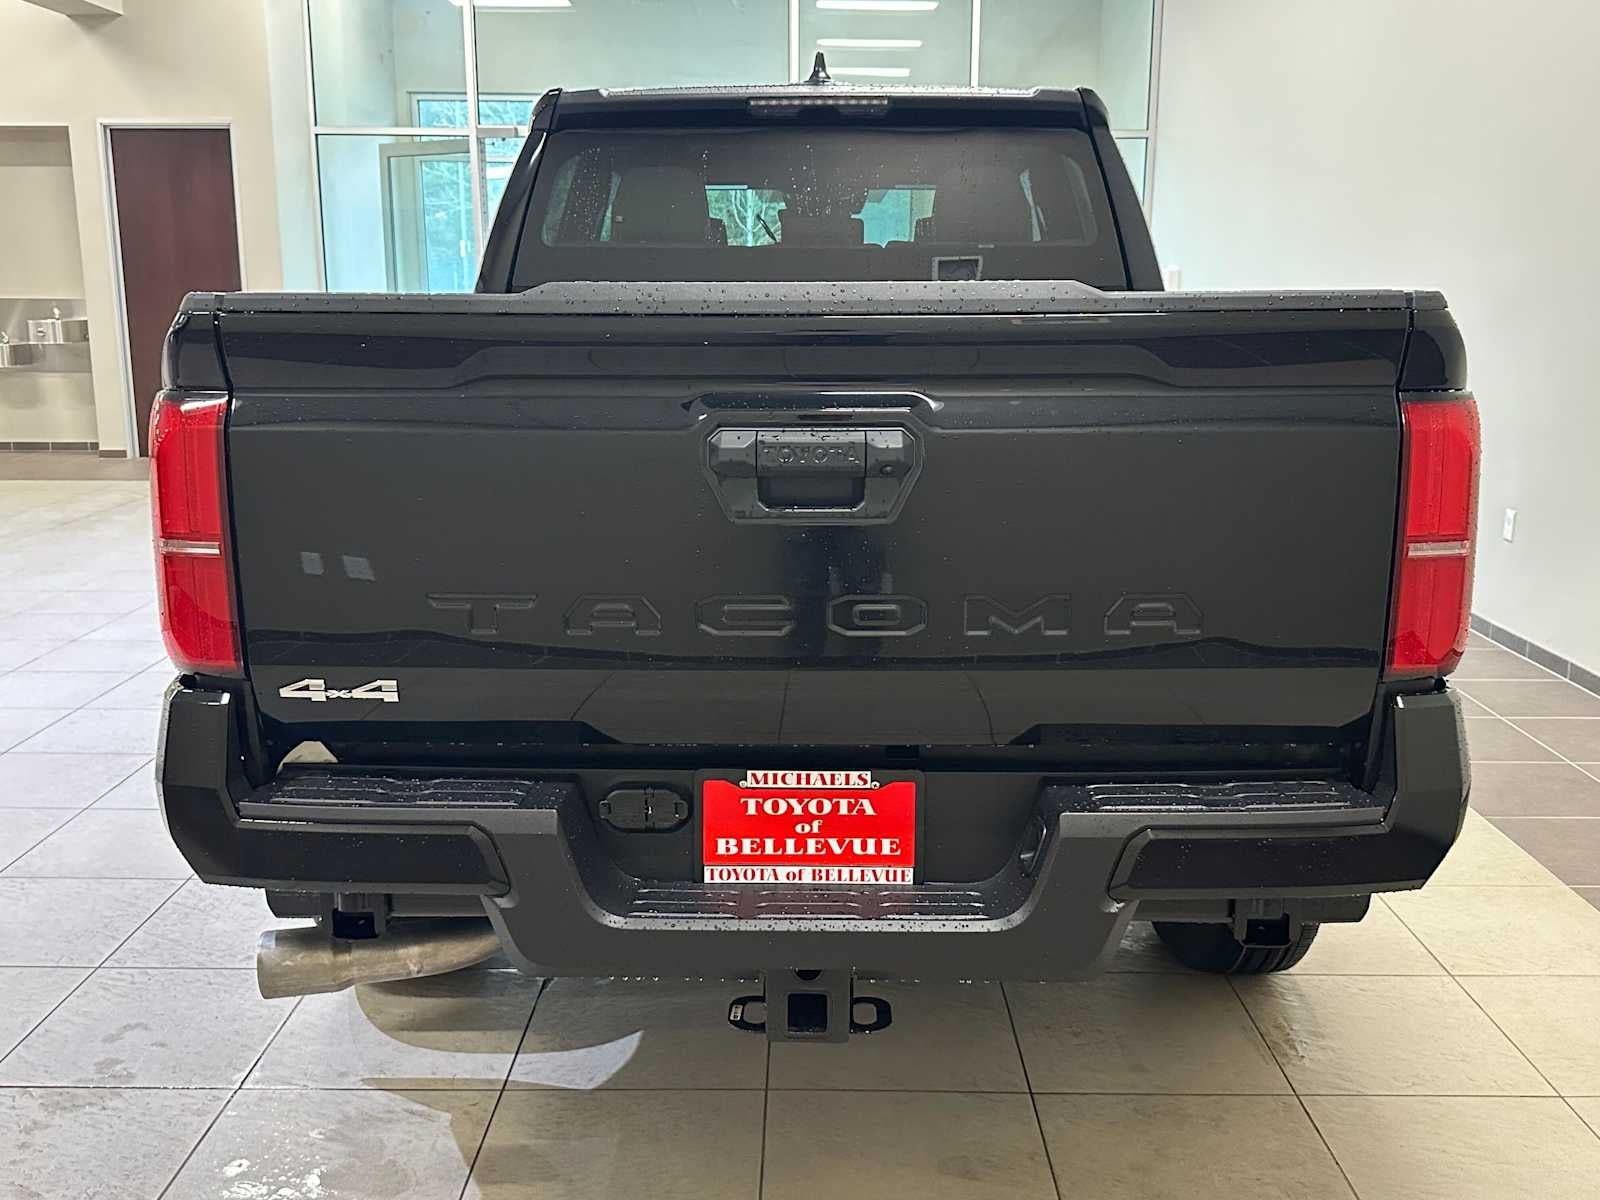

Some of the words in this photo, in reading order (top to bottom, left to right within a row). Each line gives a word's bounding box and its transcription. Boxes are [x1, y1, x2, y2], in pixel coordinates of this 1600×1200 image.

[762, 445, 861, 465] TOYOTA
[426, 592, 1204, 637] TACOMA
[279, 678, 399, 702] 4x4
[750, 772, 869, 785] MICHAELS
[740, 797, 877, 816] TOYOTA
[795, 819, 823, 834] of
[715, 837, 901, 856] BELLEVUE
[707, 867, 780, 881] TOYOTA
[786, 868, 806, 882] of
[812, 868, 912, 882] BELLEVUE
